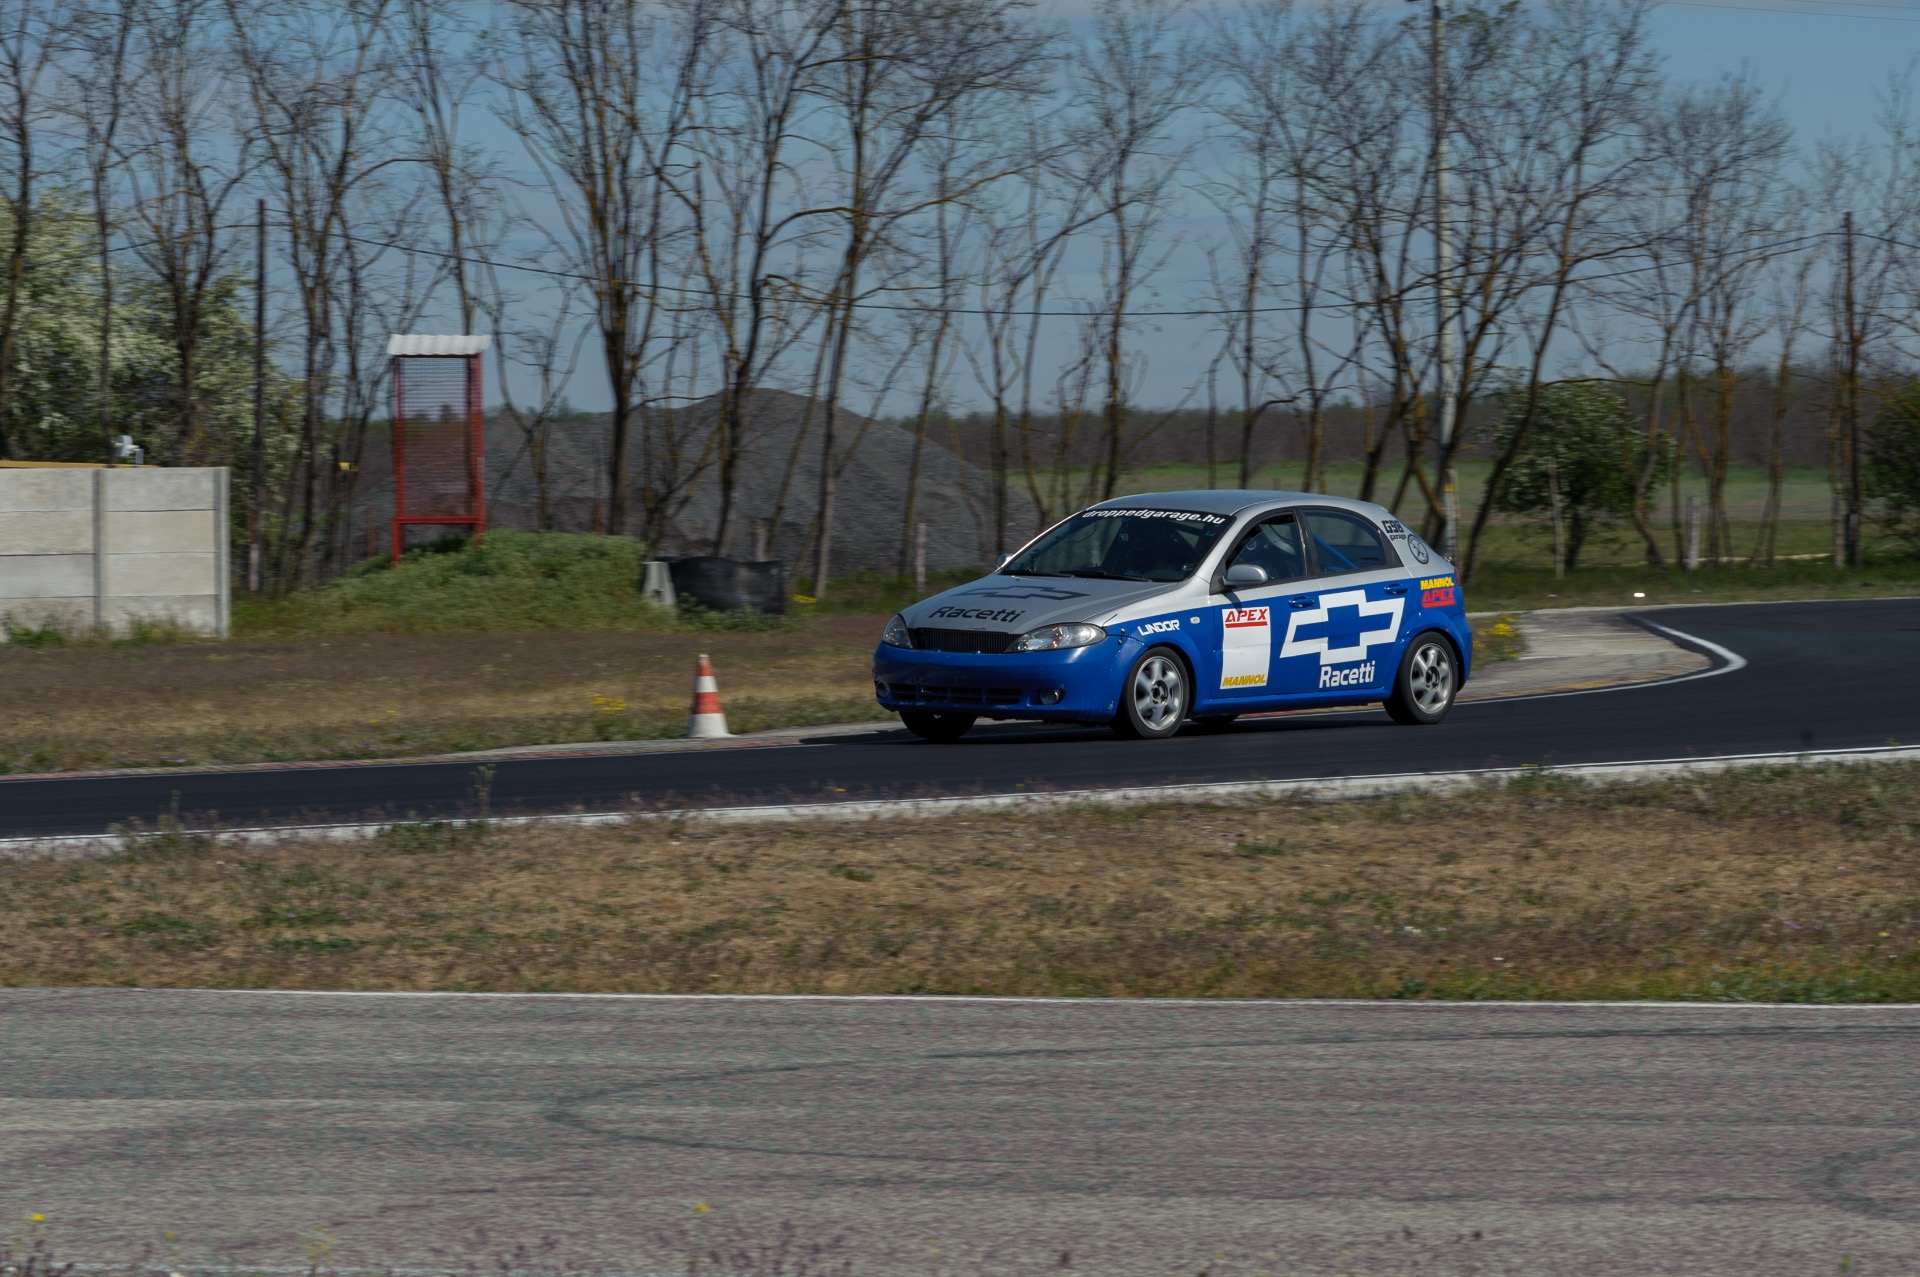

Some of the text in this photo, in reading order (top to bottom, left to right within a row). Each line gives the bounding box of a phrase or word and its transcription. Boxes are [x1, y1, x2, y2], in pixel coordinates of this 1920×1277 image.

[1082, 509, 1226, 524] droppedgarage.hu
[1420, 577, 1454, 590] MANNOL
[1422, 587, 1455, 603] APEX
[928, 606, 1026, 623] Racetti
[1225, 608, 1268, 623] APEX
[1137, 619, 1181, 636] LINDOR
[1222, 674, 1266, 687] MANNOL
[1319, 660, 1376, 688] Racetti
